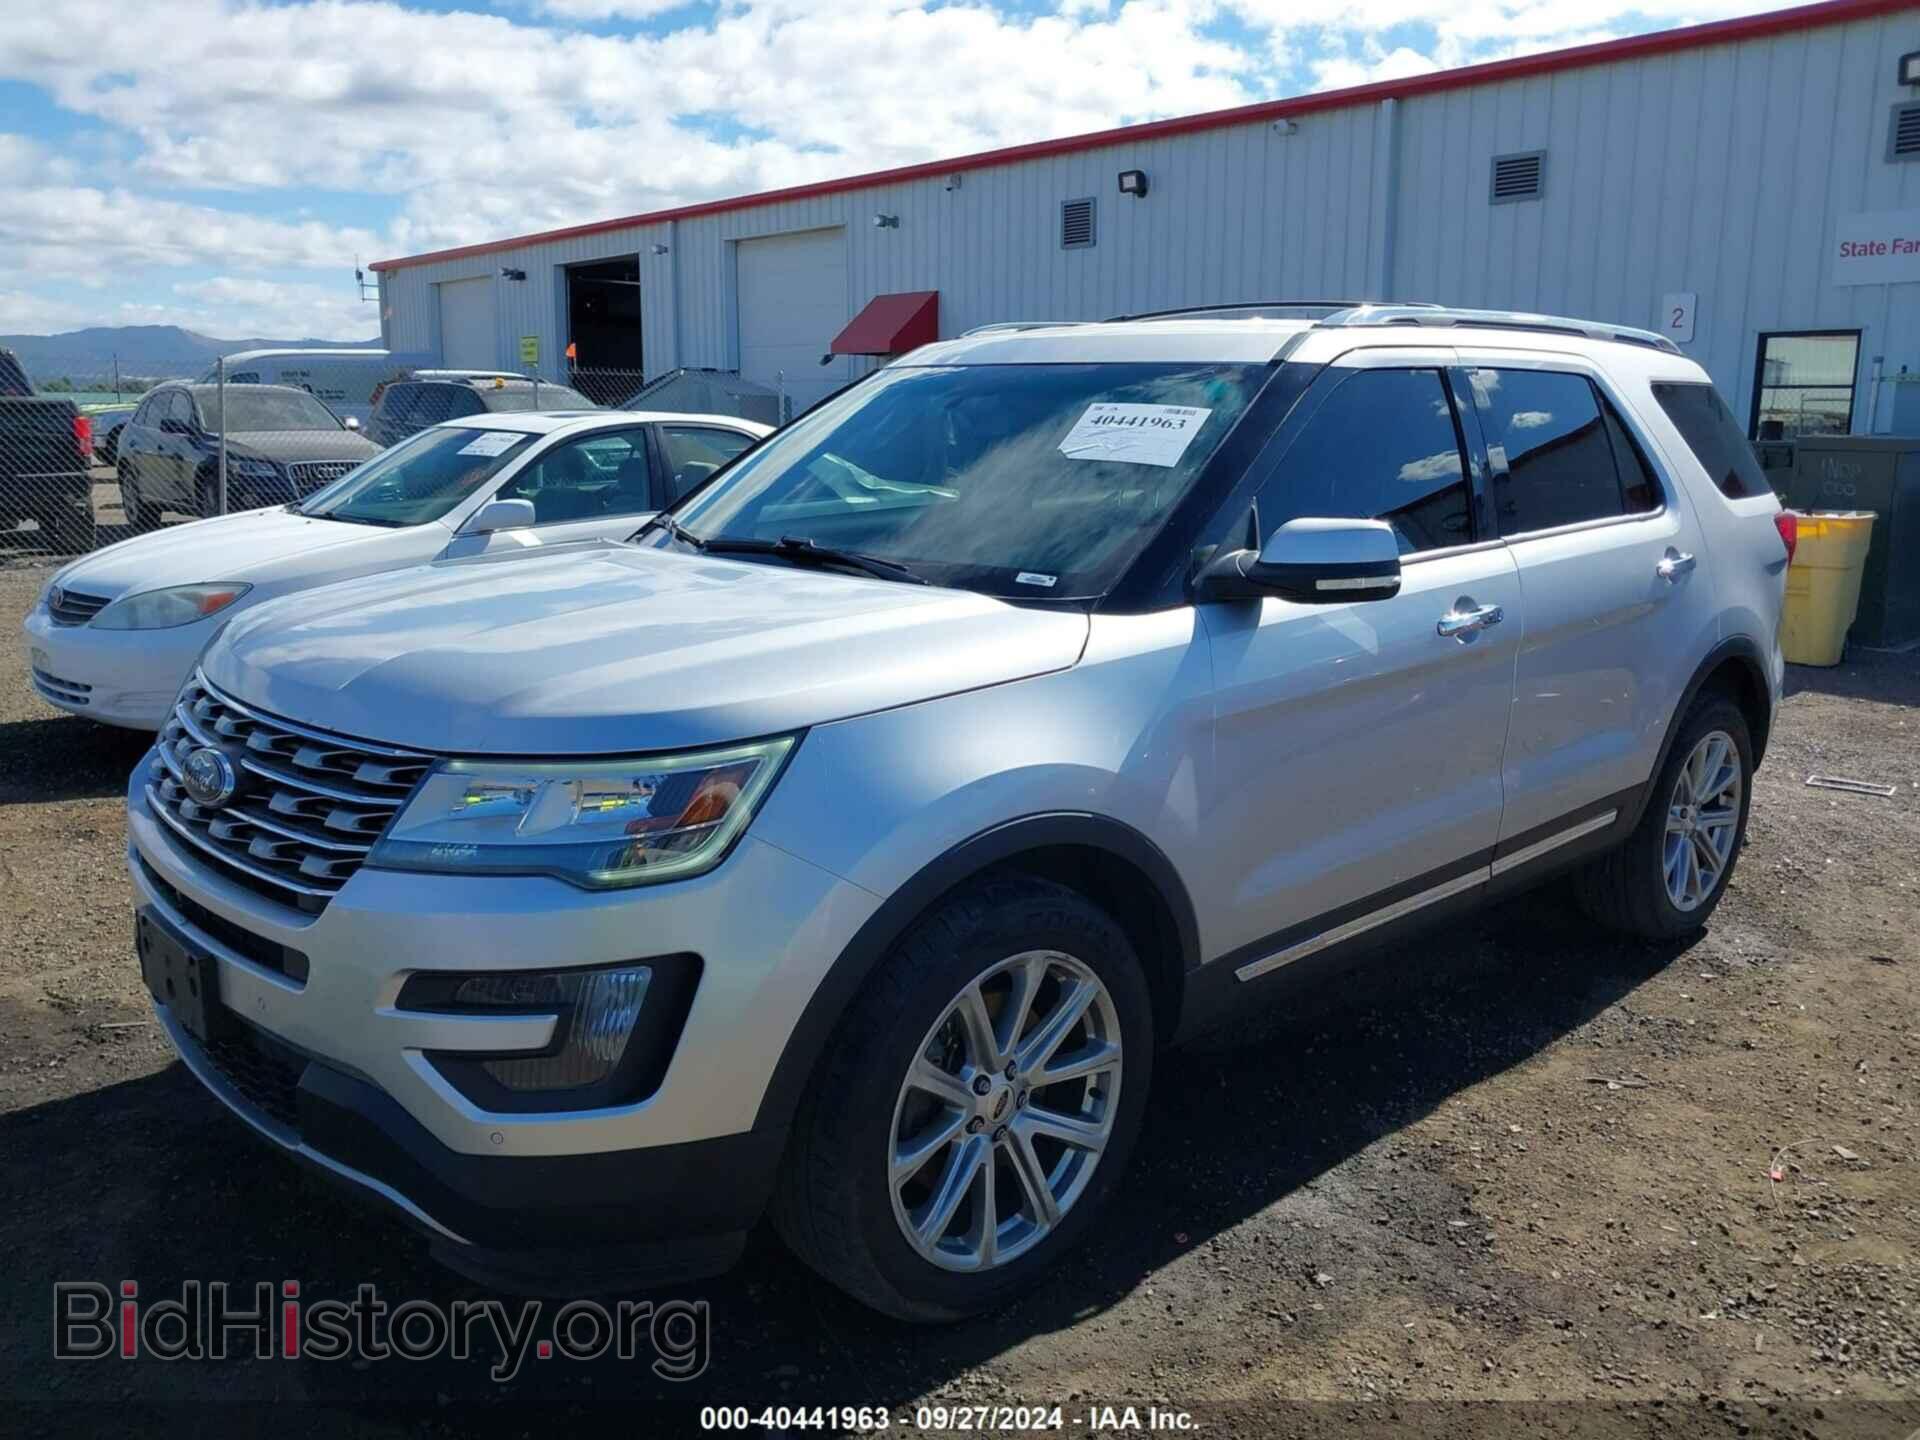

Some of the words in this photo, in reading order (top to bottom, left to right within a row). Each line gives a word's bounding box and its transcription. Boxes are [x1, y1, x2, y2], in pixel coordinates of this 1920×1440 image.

[1839, 241, 1887, 258] State
[1671, 307, 1685, 329] 2
[1091, 415, 1187, 430] 40441963
